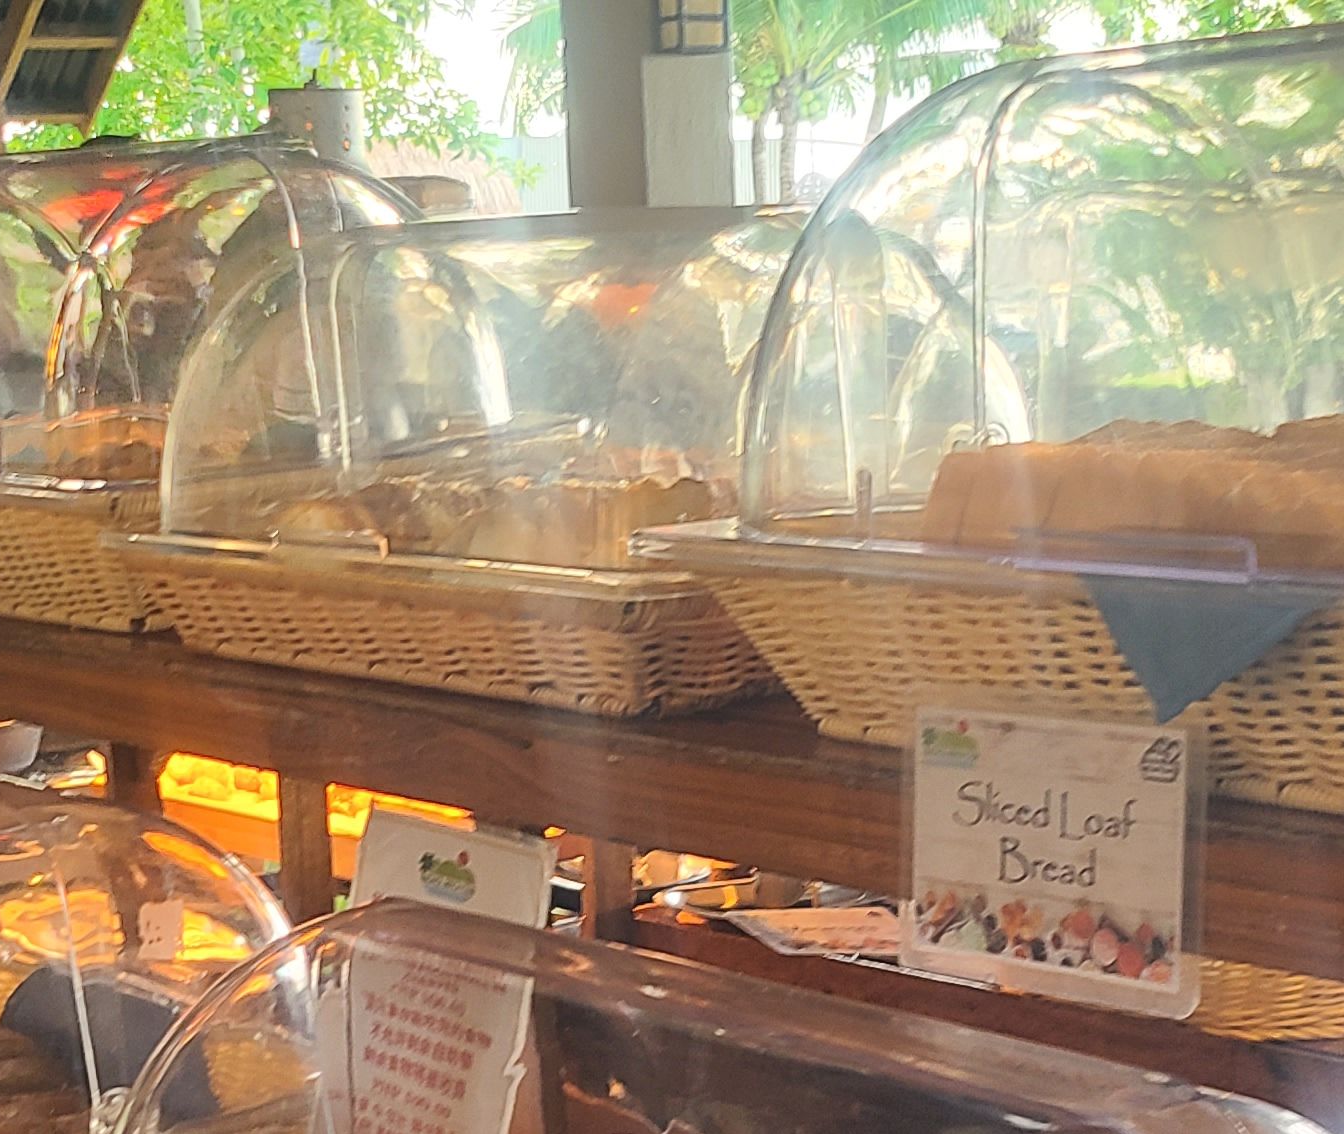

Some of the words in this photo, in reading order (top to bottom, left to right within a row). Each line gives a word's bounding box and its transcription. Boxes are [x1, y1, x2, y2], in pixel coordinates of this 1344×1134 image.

[952, 780, 1052, 828] Sliced
[1059, 791, 1138, 841] Loaf
[997, 835, 1098, 888] Bread
